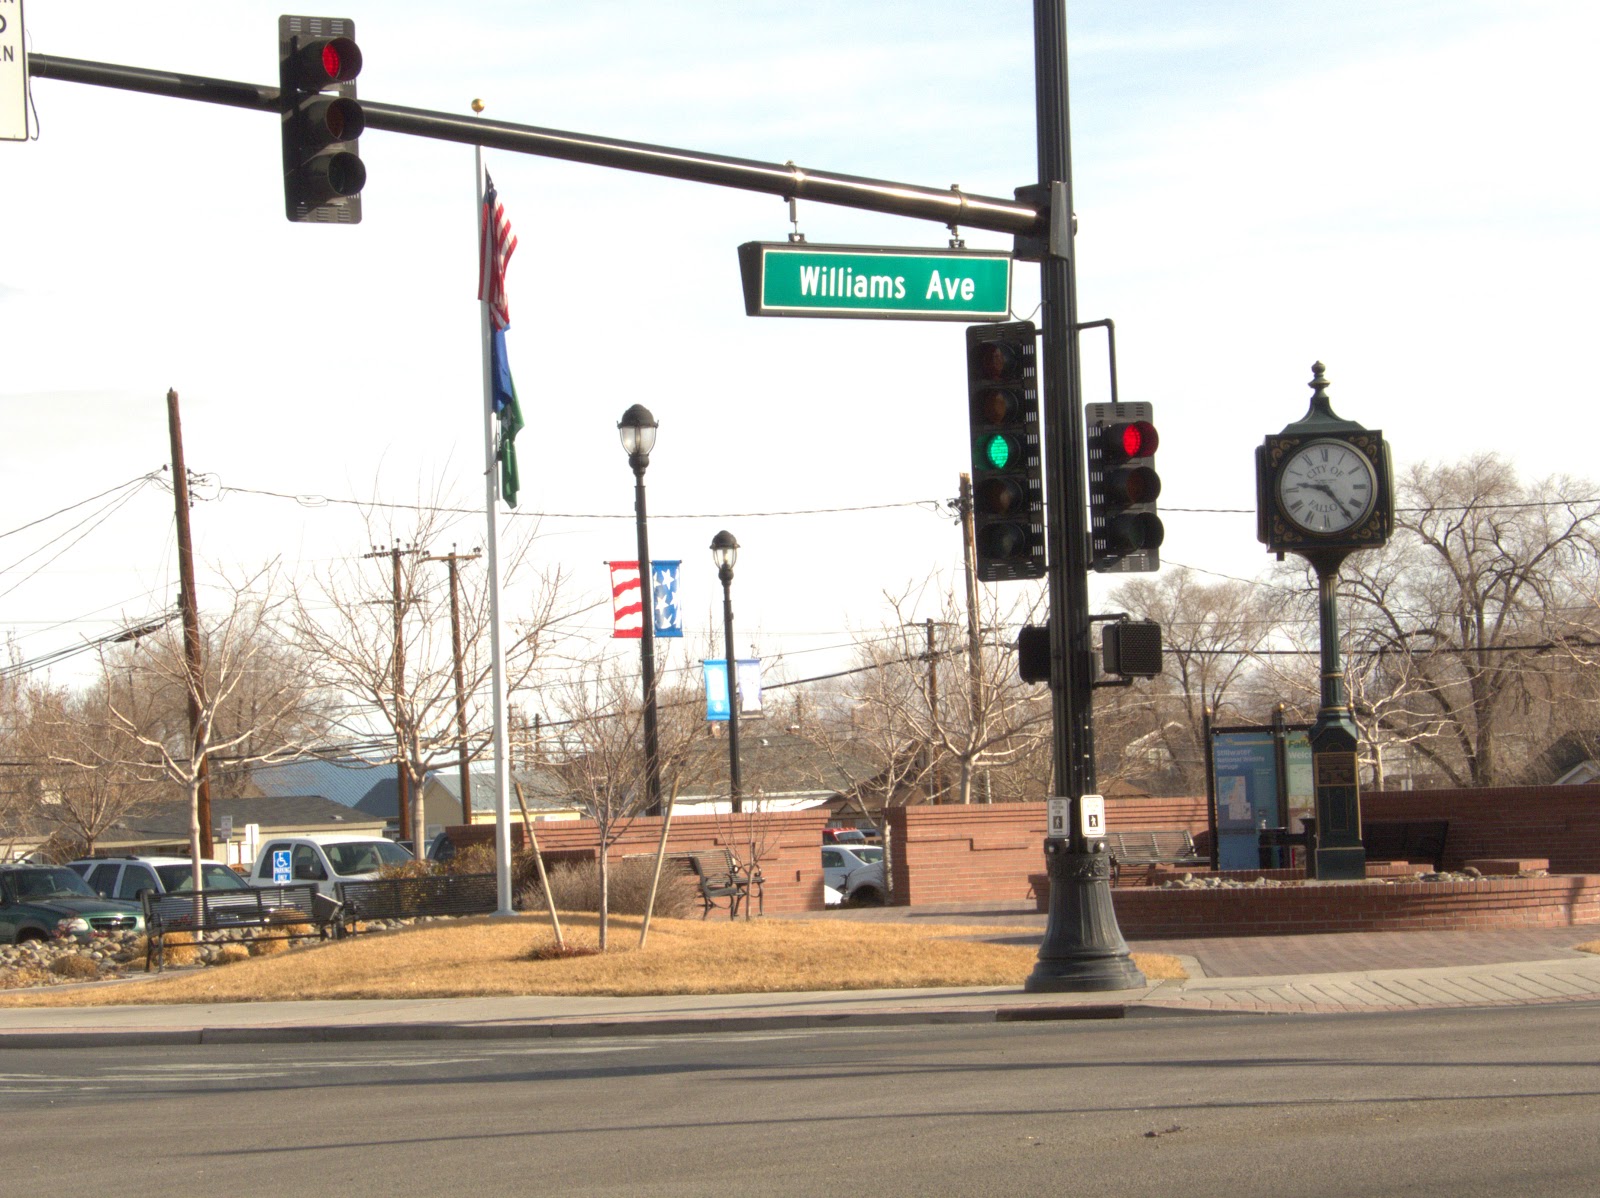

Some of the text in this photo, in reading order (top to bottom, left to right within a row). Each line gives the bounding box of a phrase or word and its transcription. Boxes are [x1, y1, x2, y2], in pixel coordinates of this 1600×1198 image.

[800, 265, 975, 301] Williams Ave
[1306, 465, 1327, 479] CITY
[1330, 466, 1345, 478] OF
